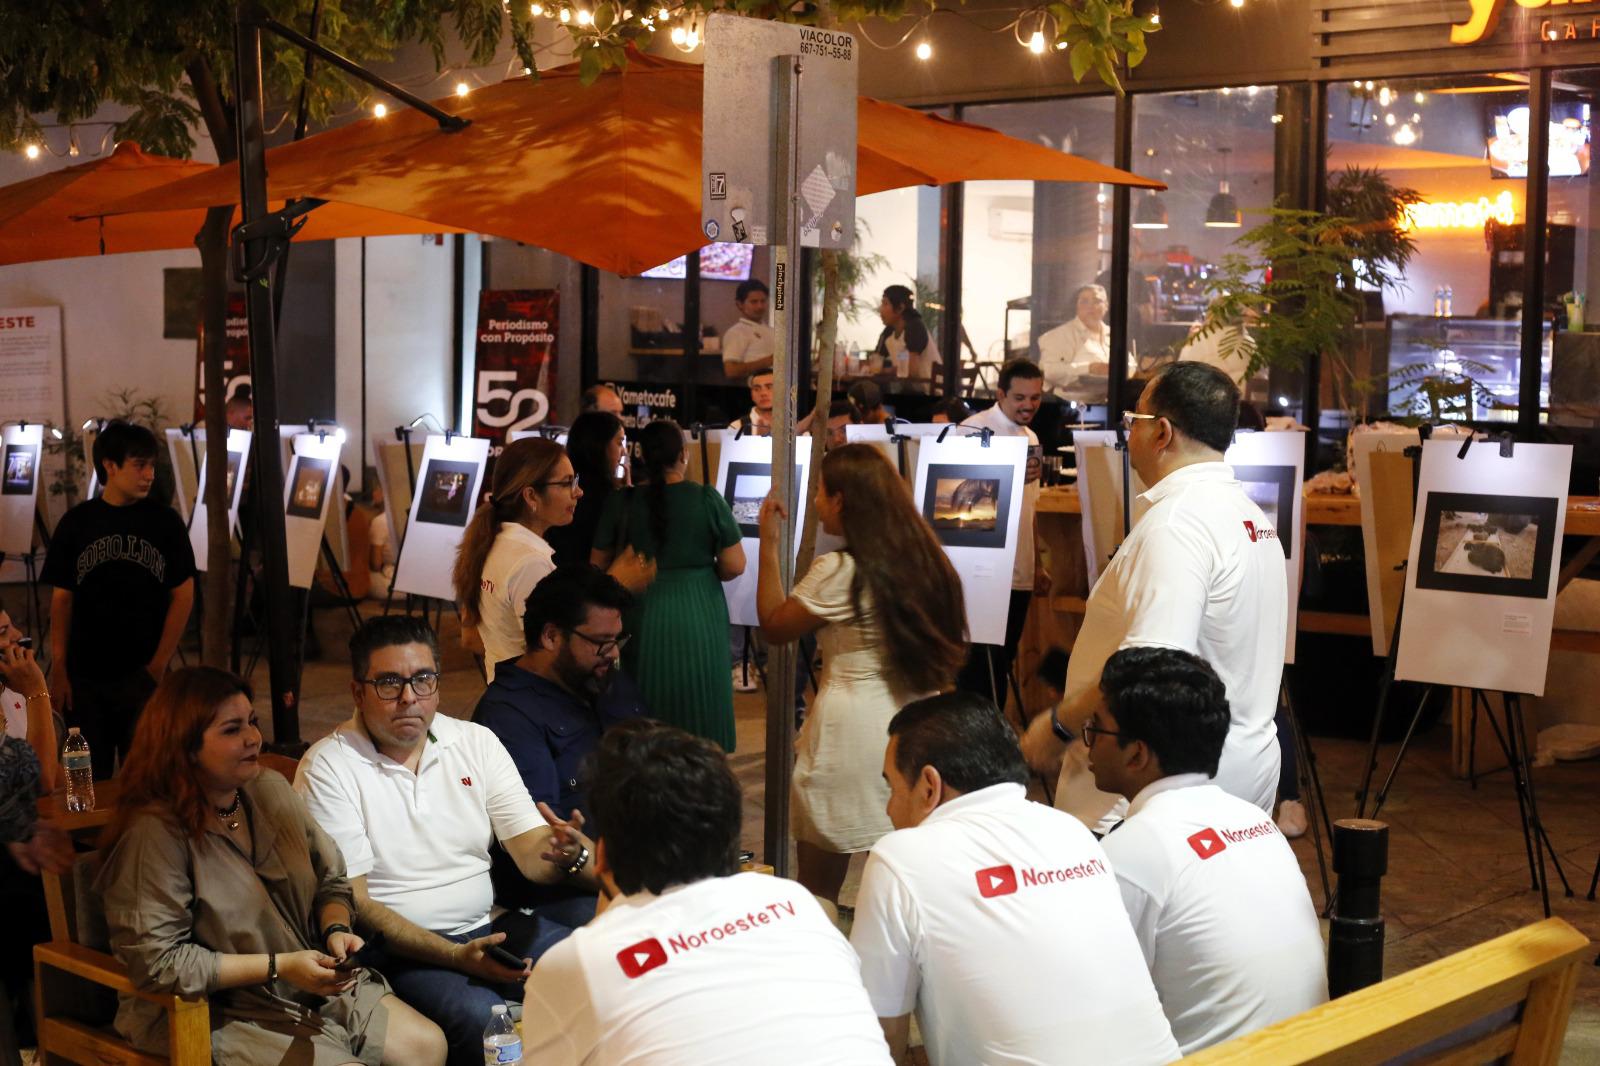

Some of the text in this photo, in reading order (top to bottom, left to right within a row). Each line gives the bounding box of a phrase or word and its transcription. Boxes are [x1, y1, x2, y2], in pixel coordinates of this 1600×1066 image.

[800, 28, 852, 48] VIACOLOR
[776, 264, 785, 309] pinchpinch
[480, 332, 555, 345] con Propósito
[488, 319, 549, 331] Periodismo
[476, 370, 549, 444] 52
[1021, 858, 1107, 887] NoroesteTV
[667, 900, 796, 954] NoroesteTV
